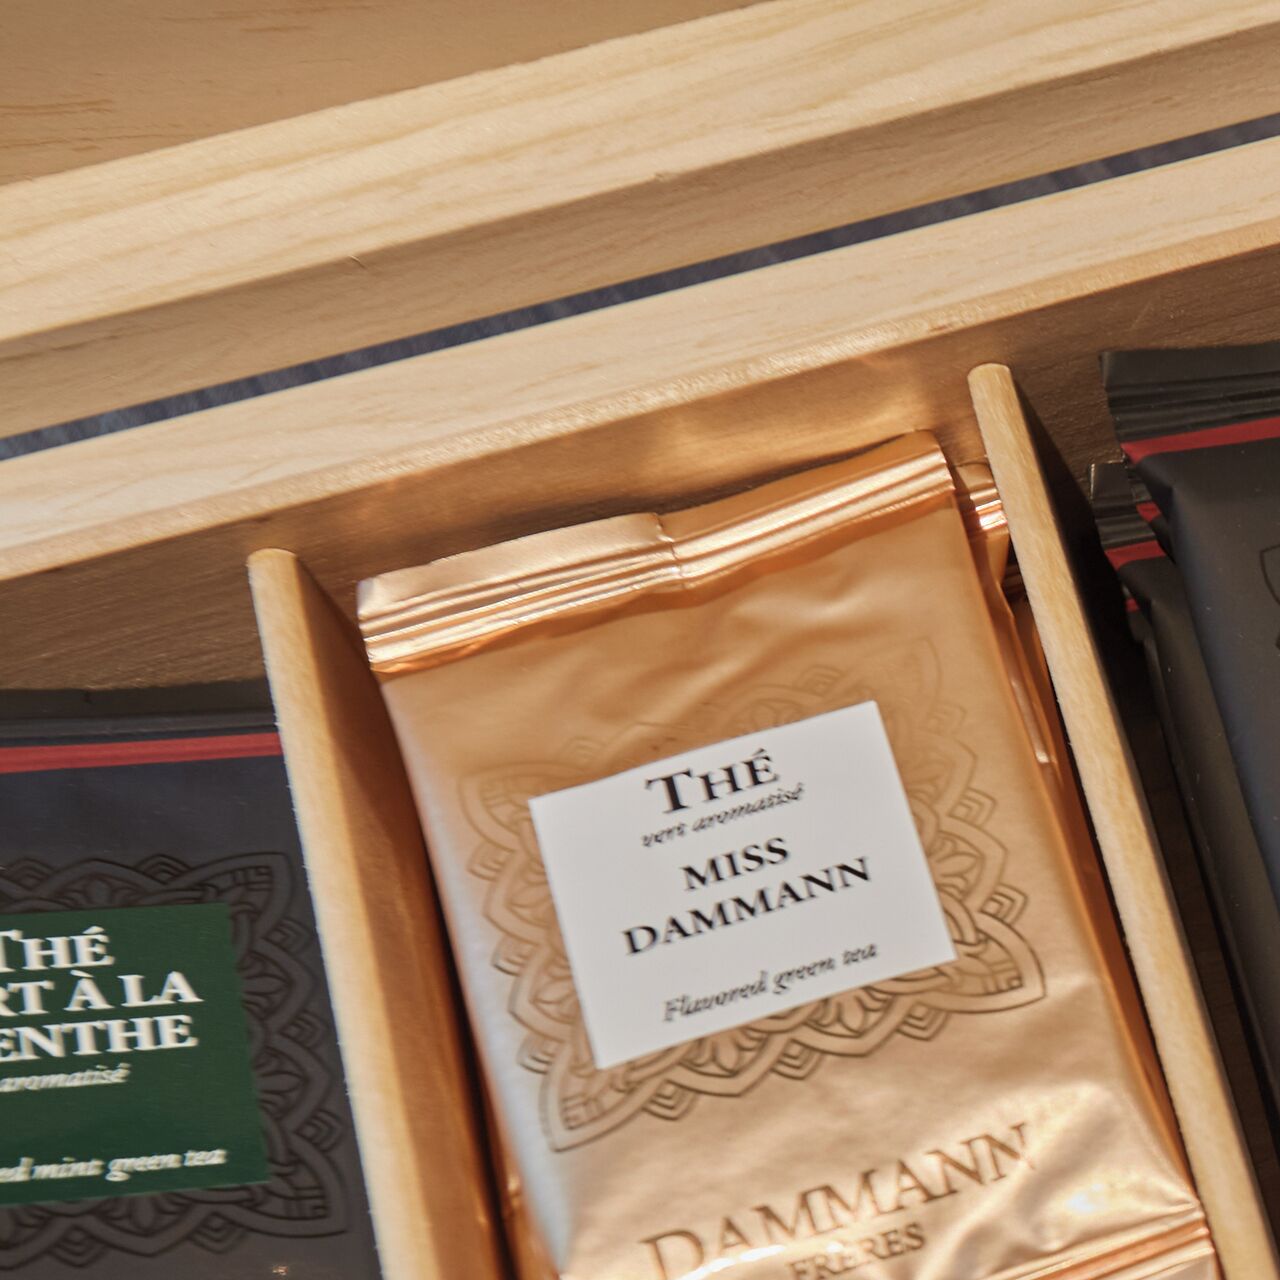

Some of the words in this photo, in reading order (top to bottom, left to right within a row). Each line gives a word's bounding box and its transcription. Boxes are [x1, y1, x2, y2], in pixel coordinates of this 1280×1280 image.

[644, 747, 779, 815] THÉ
[692, 782, 805, 832] aromatisé
[680, 837, 789, 891] MISS
[622, 856, 871, 956] DAMMANN
[64, 969, 114, 1012] À
[118, 971, 204, 1008] LA
[662, 971, 768, 1022] Flavored
[773, 955, 836, 995] green
[842, 943, 879, 967] tea
[105, 1152, 182, 1182] green
[183, 1148, 228, 1167] tea
